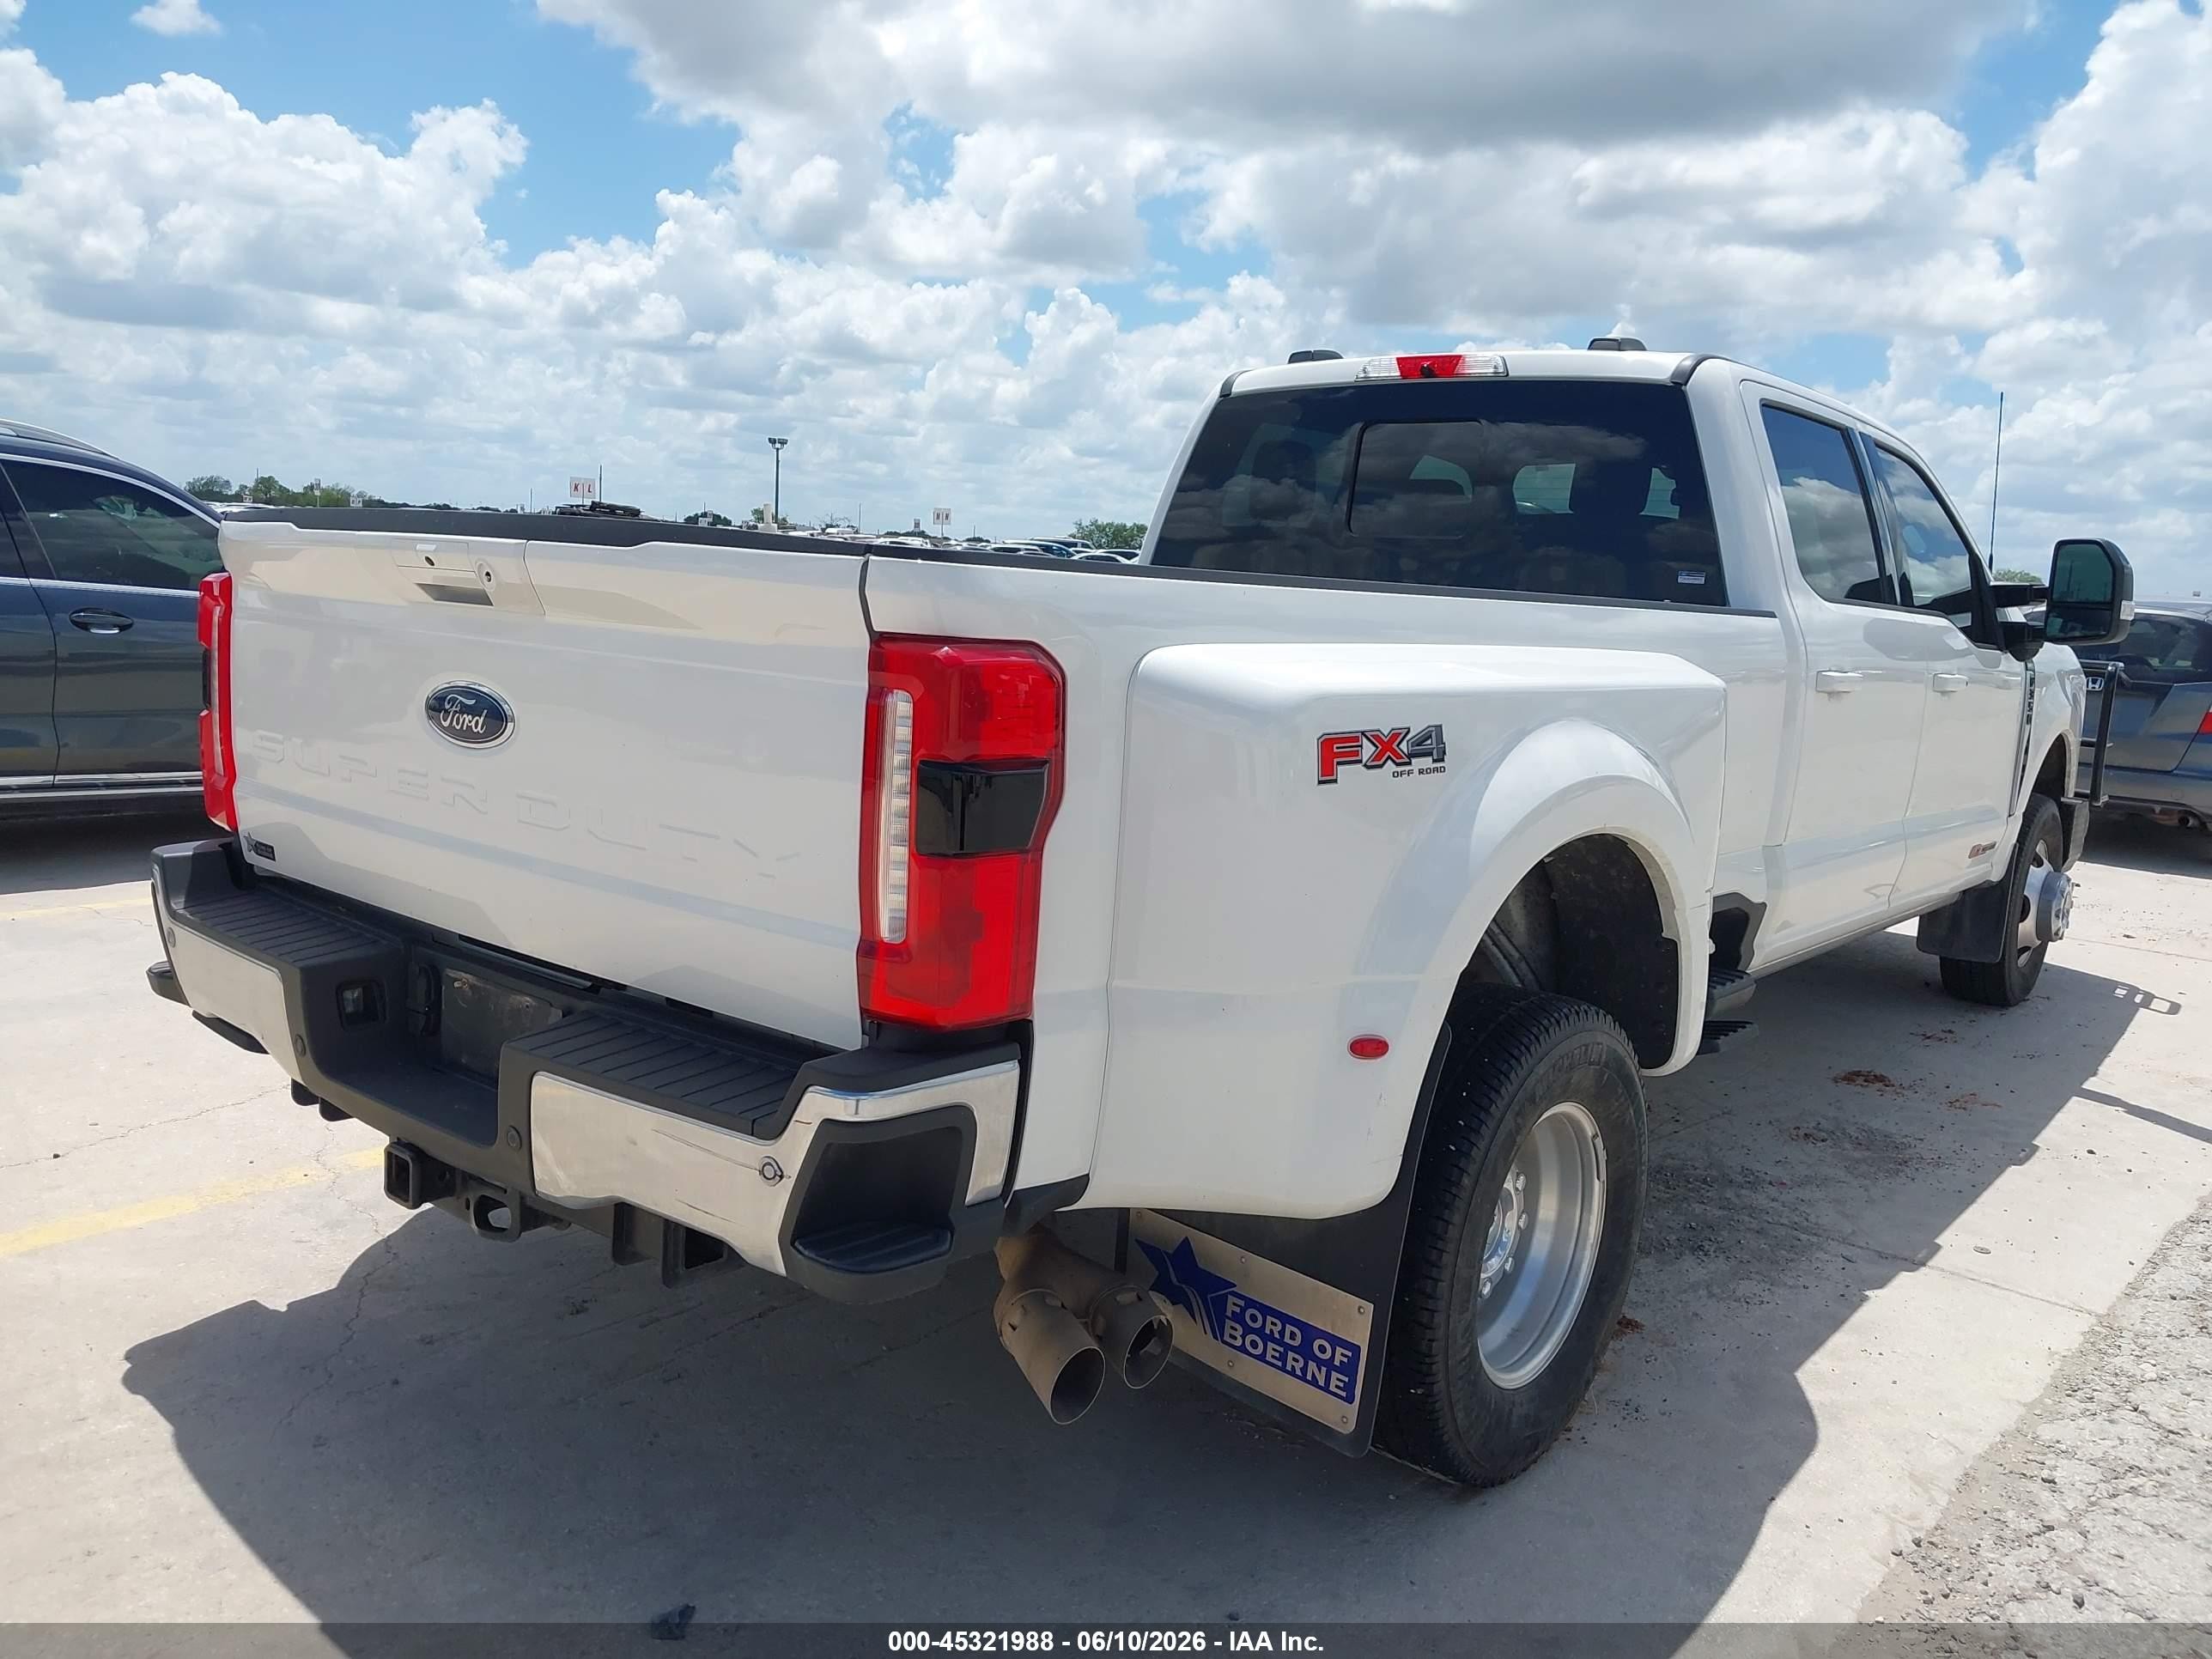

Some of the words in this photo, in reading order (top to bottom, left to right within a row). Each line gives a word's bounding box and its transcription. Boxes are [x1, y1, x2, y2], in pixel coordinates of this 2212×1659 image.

[573, 483, 580, 493] K
[587, 483, 592, 494] L
[440, 694, 489, 734] Ford
[252, 728, 489, 815] SUPER
[1316, 724, 1447, 786] FX4
[1392, 769, 1415, 779] OFF
[1418, 765, 1447, 776] ROAD
[1223, 1318, 1350, 1398] BOERNE
[1225, 1293, 1303, 1346] FORD
[1313, 1338, 1352, 1367] OF
